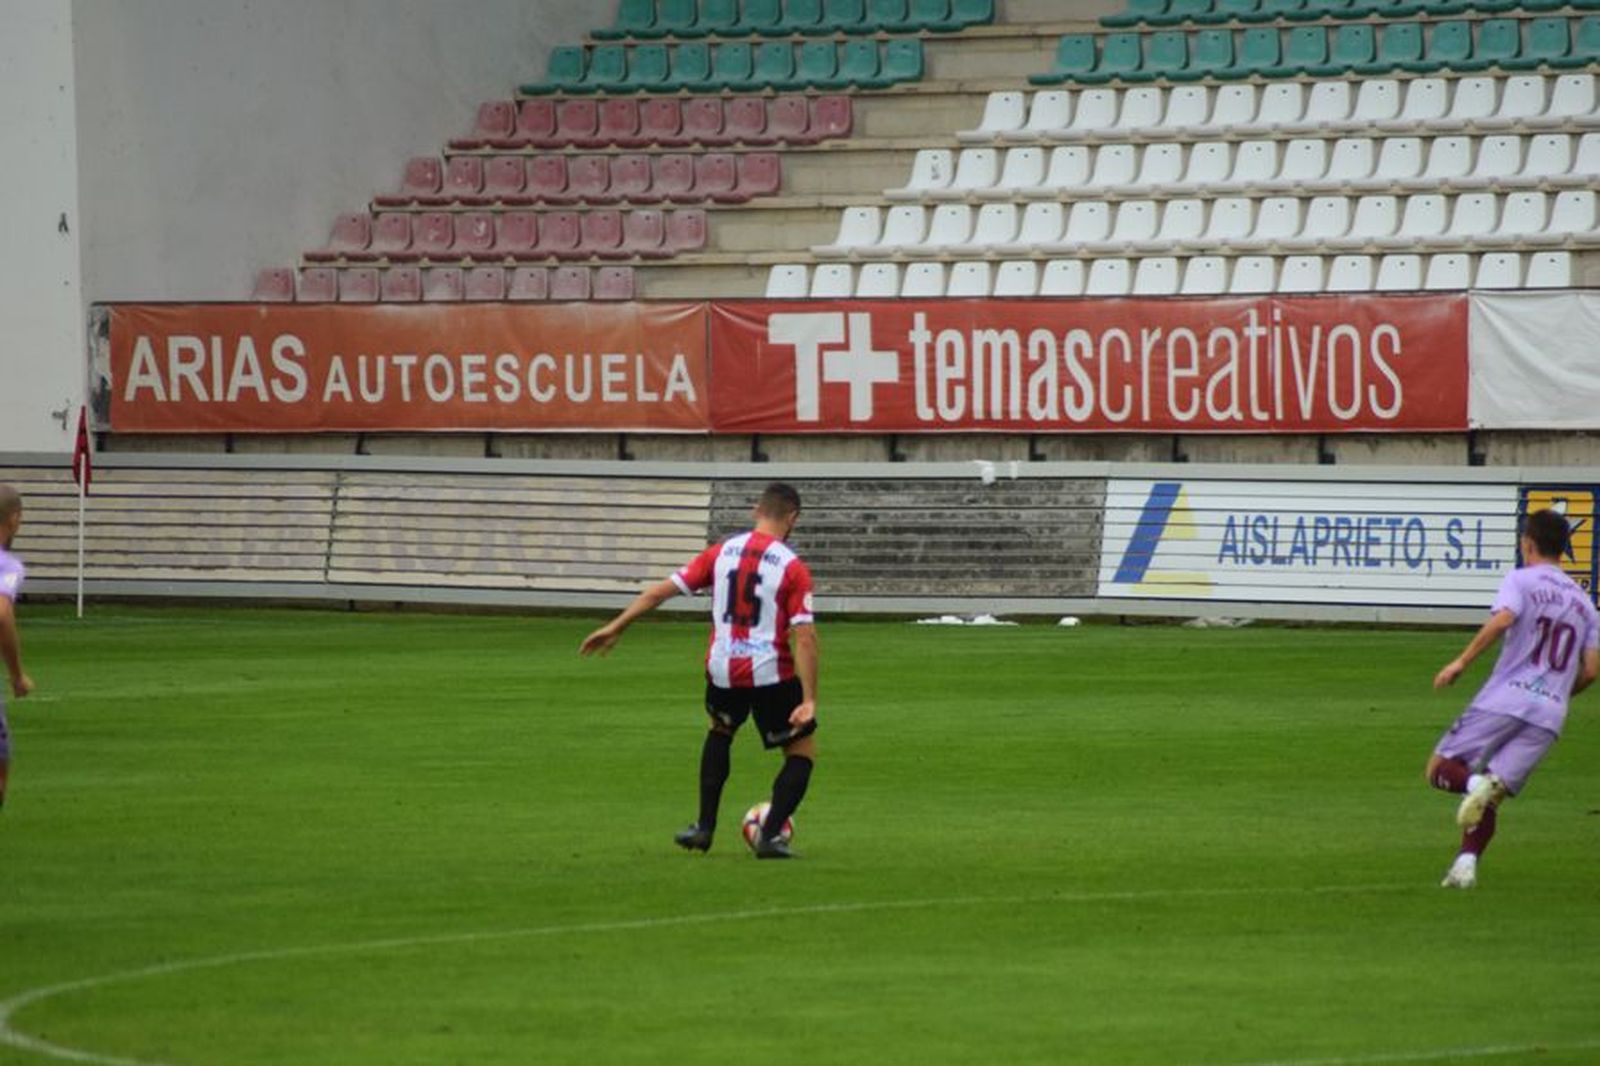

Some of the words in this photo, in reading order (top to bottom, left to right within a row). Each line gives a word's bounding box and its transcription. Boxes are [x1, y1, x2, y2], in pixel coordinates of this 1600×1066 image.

[123, 333, 308, 403] ARIAS
[322, 353, 697, 404] AUTOESCUELA
[908, 309, 1403, 422] temascreativos
[1218, 515, 1433, 577] AISLAPRIETO,
[1445, 517, 1500, 569] S.L.
[1531, 616, 1577, 672] 10
